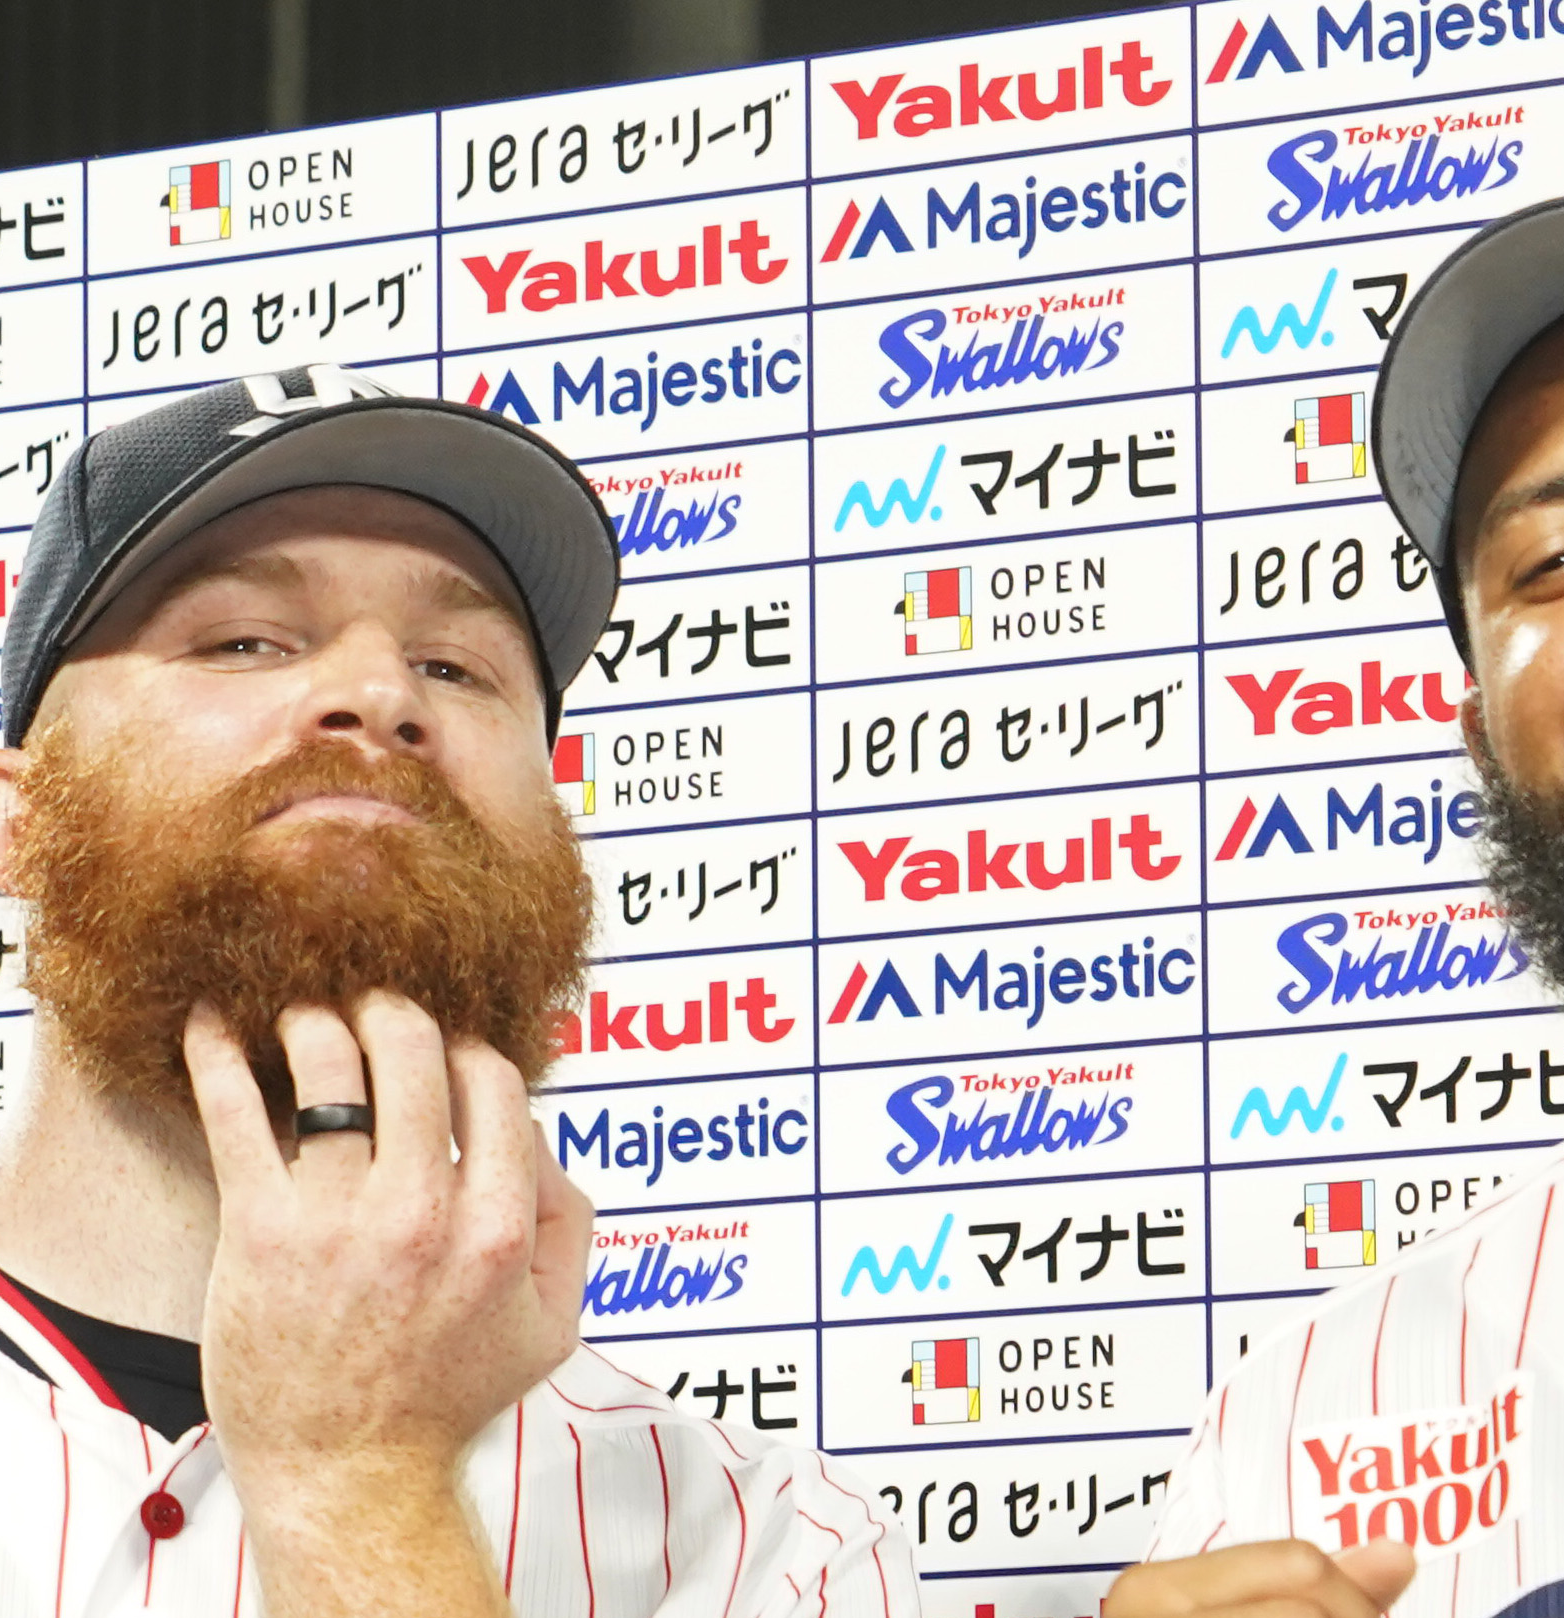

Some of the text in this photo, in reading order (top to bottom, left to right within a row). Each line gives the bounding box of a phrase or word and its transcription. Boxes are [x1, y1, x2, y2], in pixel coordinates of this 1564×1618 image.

[829, 39, 1174, 141] Yakult
[1343, 106, 1525, 146] Tokyo Yakult
[248, 148, 352, 191] OPEN
[1266, 129, 1523, 233] Swallows
[250, 192, 352, 230] HOUSE
[926, 162, 1186, 259] Majestic
[460, 219, 790, 315] Yakult
[951, 287, 1125, 325] Tokyo Yakult
[552, 338, 801, 432] Majestic
[877, 309, 1125, 410] Swallows
[659, 461, 744, 486] Yakult
[960, 429, 1177, 516] マイナビ
[991, 557, 1105, 600] OPEN
[592, 598, 792, 684] マイナビ
[993, 604, 1105, 641] HOUSE
[613, 725, 722, 766] OPEN
[615, 771, 723, 806] HOUSE
[836, 813, 1183, 903] Yakult
[1353, 909, 1439, 931] Tokyo
[933, 937, 1194, 1030] Majestic
[959, 1062, 1134, 1094] Tokyo Yakult
[556, 1095, 810, 1189] Majestic
[884, 1074, 1134, 1176] Swallows
[664, 1221, 750, 1243] Yakult
[968, 1208, 1186, 1287] マイナビ
[999, 1334, 1114, 1373] OPEN
[1001, 1381, 1114, 1414] HOUSE
[1302, 1384, 1525, 1497] Yakult
[1323, 1460, 1510, 1553] 1000
